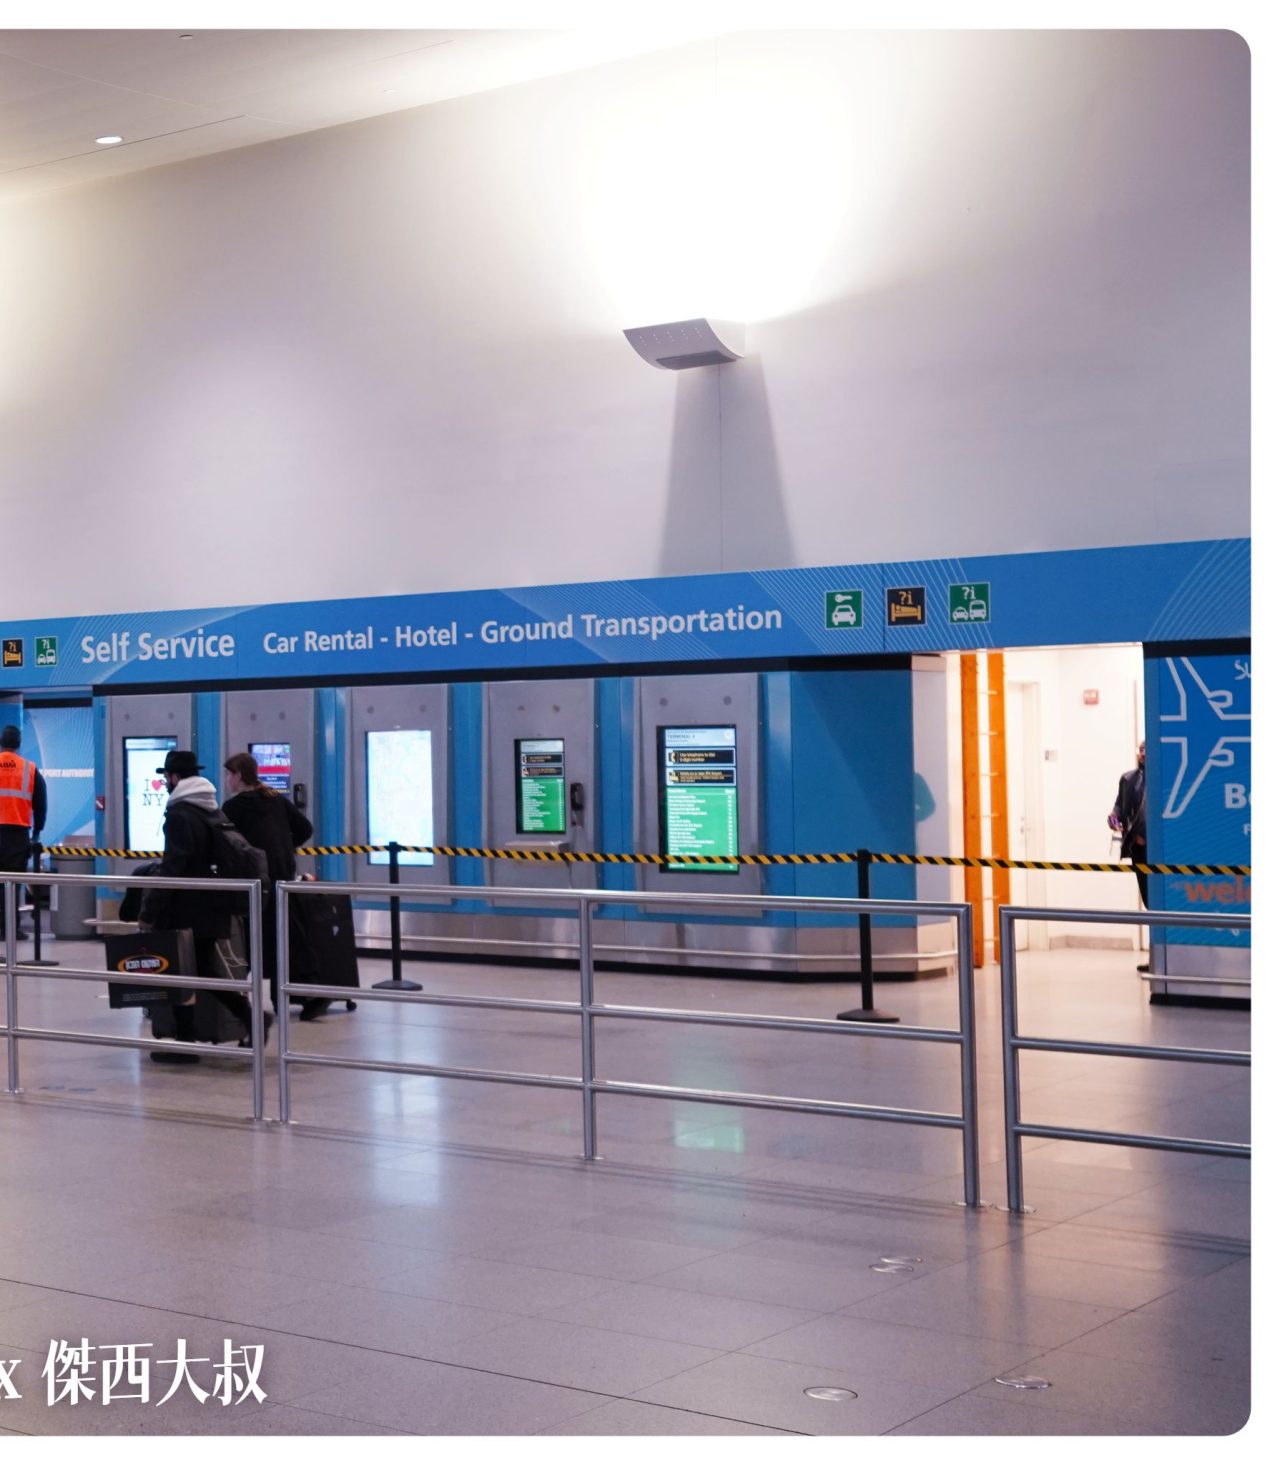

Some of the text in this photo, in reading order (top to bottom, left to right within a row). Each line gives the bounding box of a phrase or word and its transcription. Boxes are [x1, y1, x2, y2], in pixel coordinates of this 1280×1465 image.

[263, 632, 299, 653] Car
[305, 626, 373, 652] Rental
[396, 621, 457, 648] Hotel
[481, 614, 573, 644] Ground
[581, 605, 782, 641] Transportation
[81, 628, 235, 664] Self Service
[145, 778, 150, 792] I
[1224, 783, 1251, 810] B
[143, 793, 166, 807] NY
